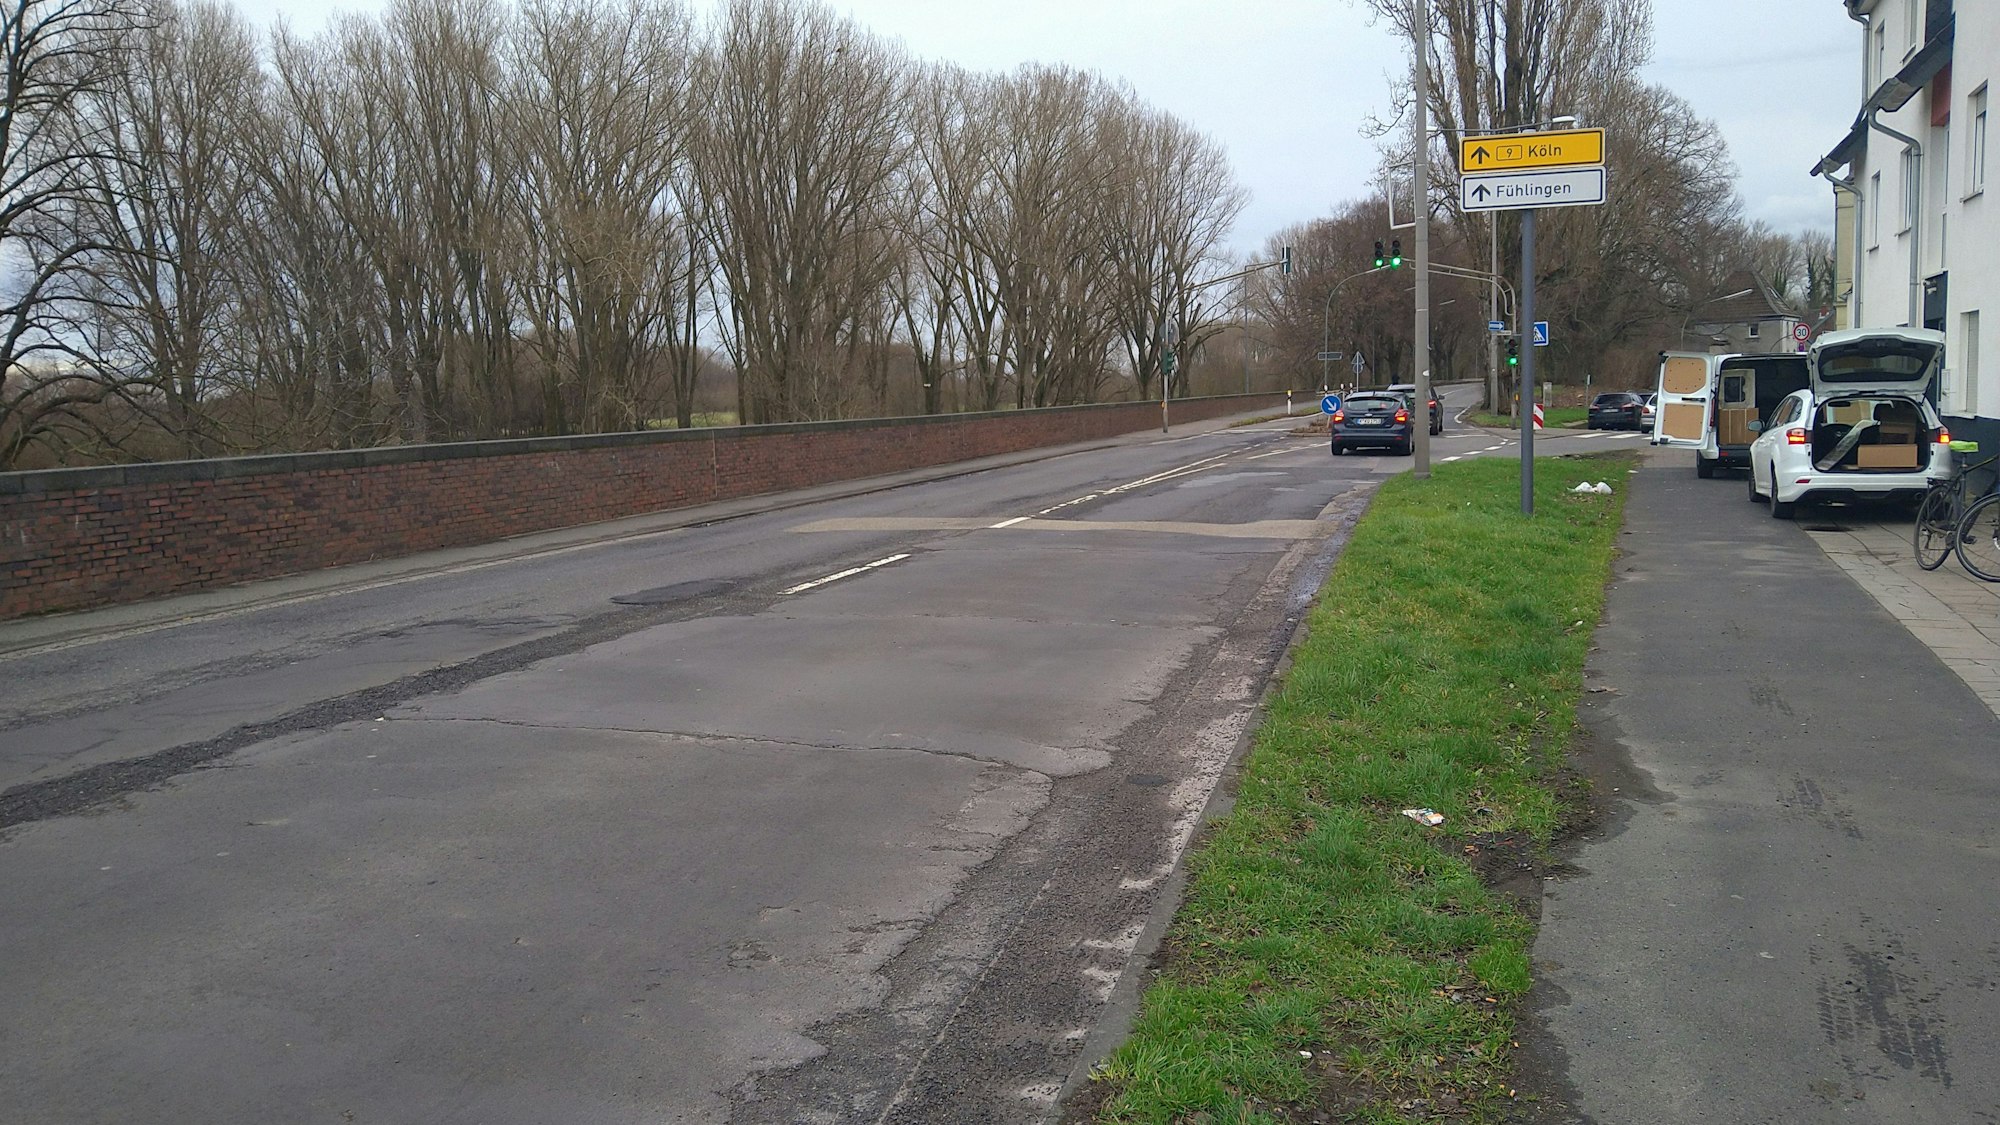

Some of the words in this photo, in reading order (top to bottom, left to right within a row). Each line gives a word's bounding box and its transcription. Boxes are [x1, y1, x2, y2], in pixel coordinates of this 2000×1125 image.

[1506, 148, 1513, 158] 9
[1528, 144, 1562, 158] Köln
[1496, 183, 1571, 198] Fühlingen
[1796, 328, 1807, 337] 30
